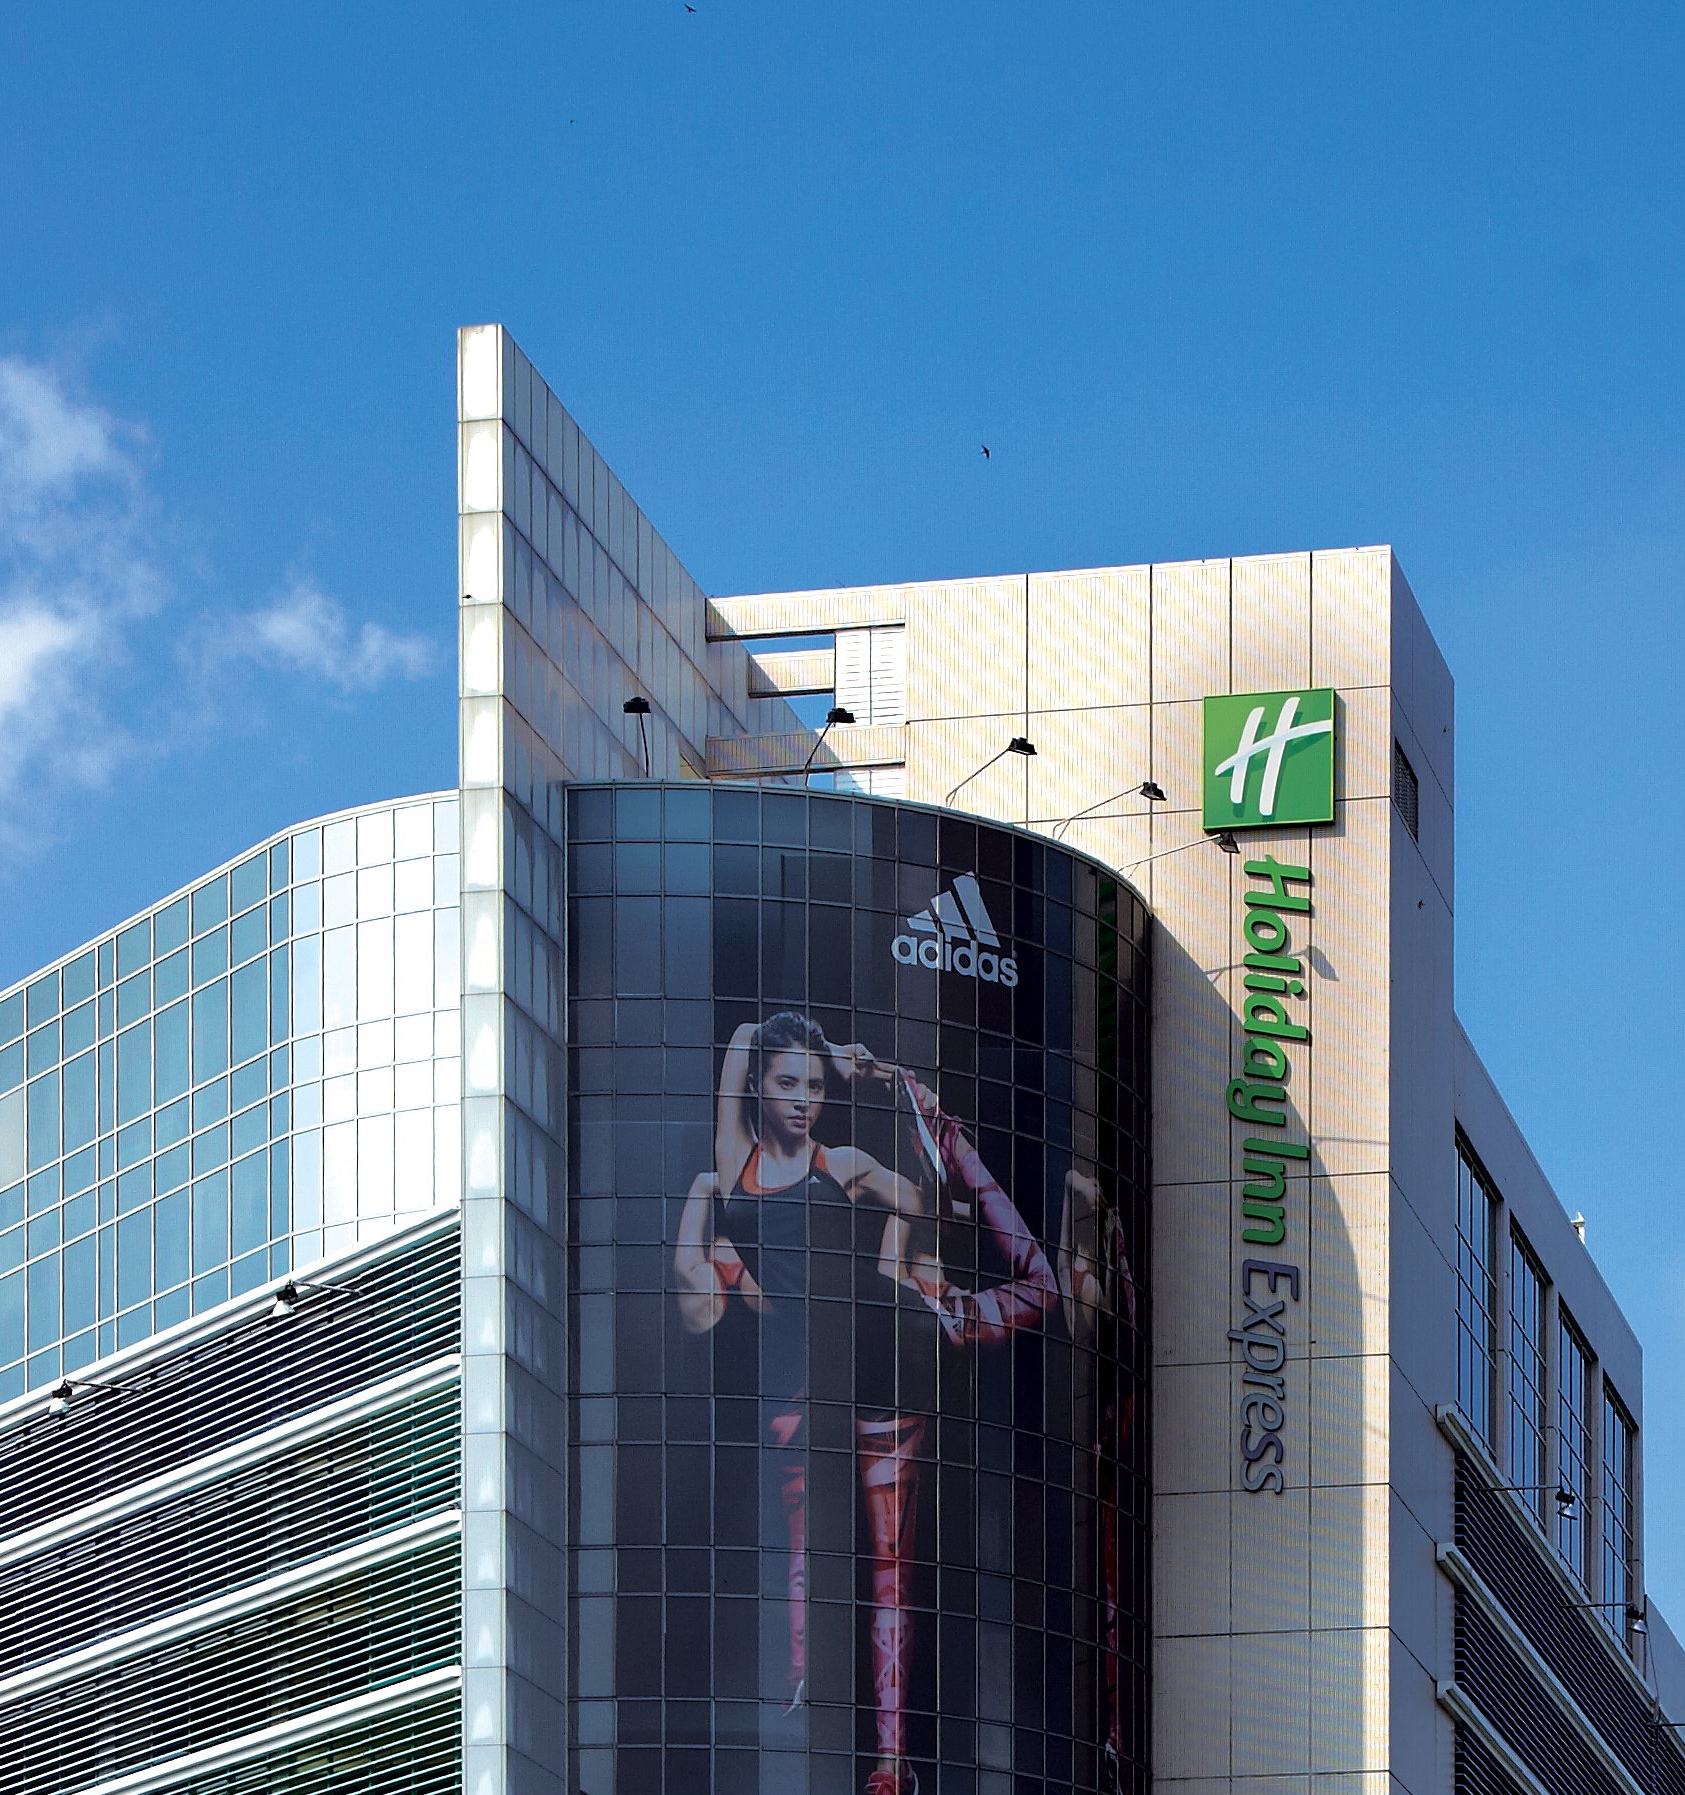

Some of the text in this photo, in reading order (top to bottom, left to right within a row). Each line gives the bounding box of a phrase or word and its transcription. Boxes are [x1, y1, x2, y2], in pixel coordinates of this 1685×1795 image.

[890, 932, 1020, 988] adidas
[1226, 854, 1312, 1496] Holiday Inn Express
